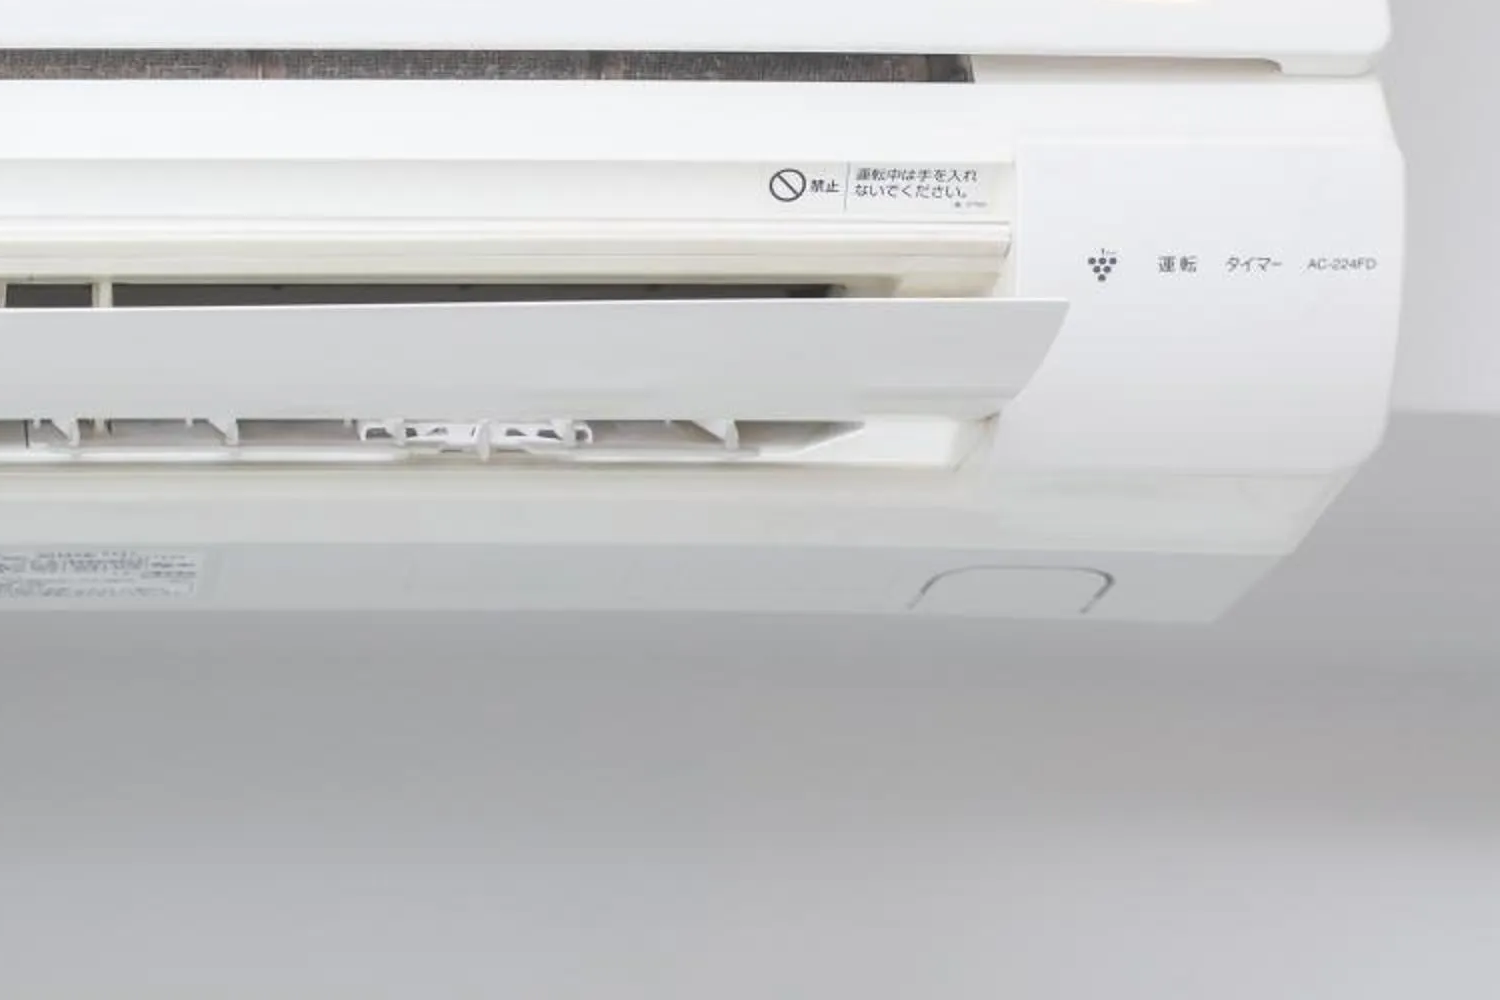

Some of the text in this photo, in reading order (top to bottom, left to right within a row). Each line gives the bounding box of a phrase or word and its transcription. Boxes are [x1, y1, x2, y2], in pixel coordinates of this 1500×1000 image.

[855, 167, 978, 182] 運転中は手を入れ
[810, 179, 840, 193] 禁止
[855, 183, 968, 199] ないでください。
[1158, 255, 1198, 273] 運転
[1225, 256, 1283, 273] タイマー
[1306, 257, 1378, 271] AC-224FD
